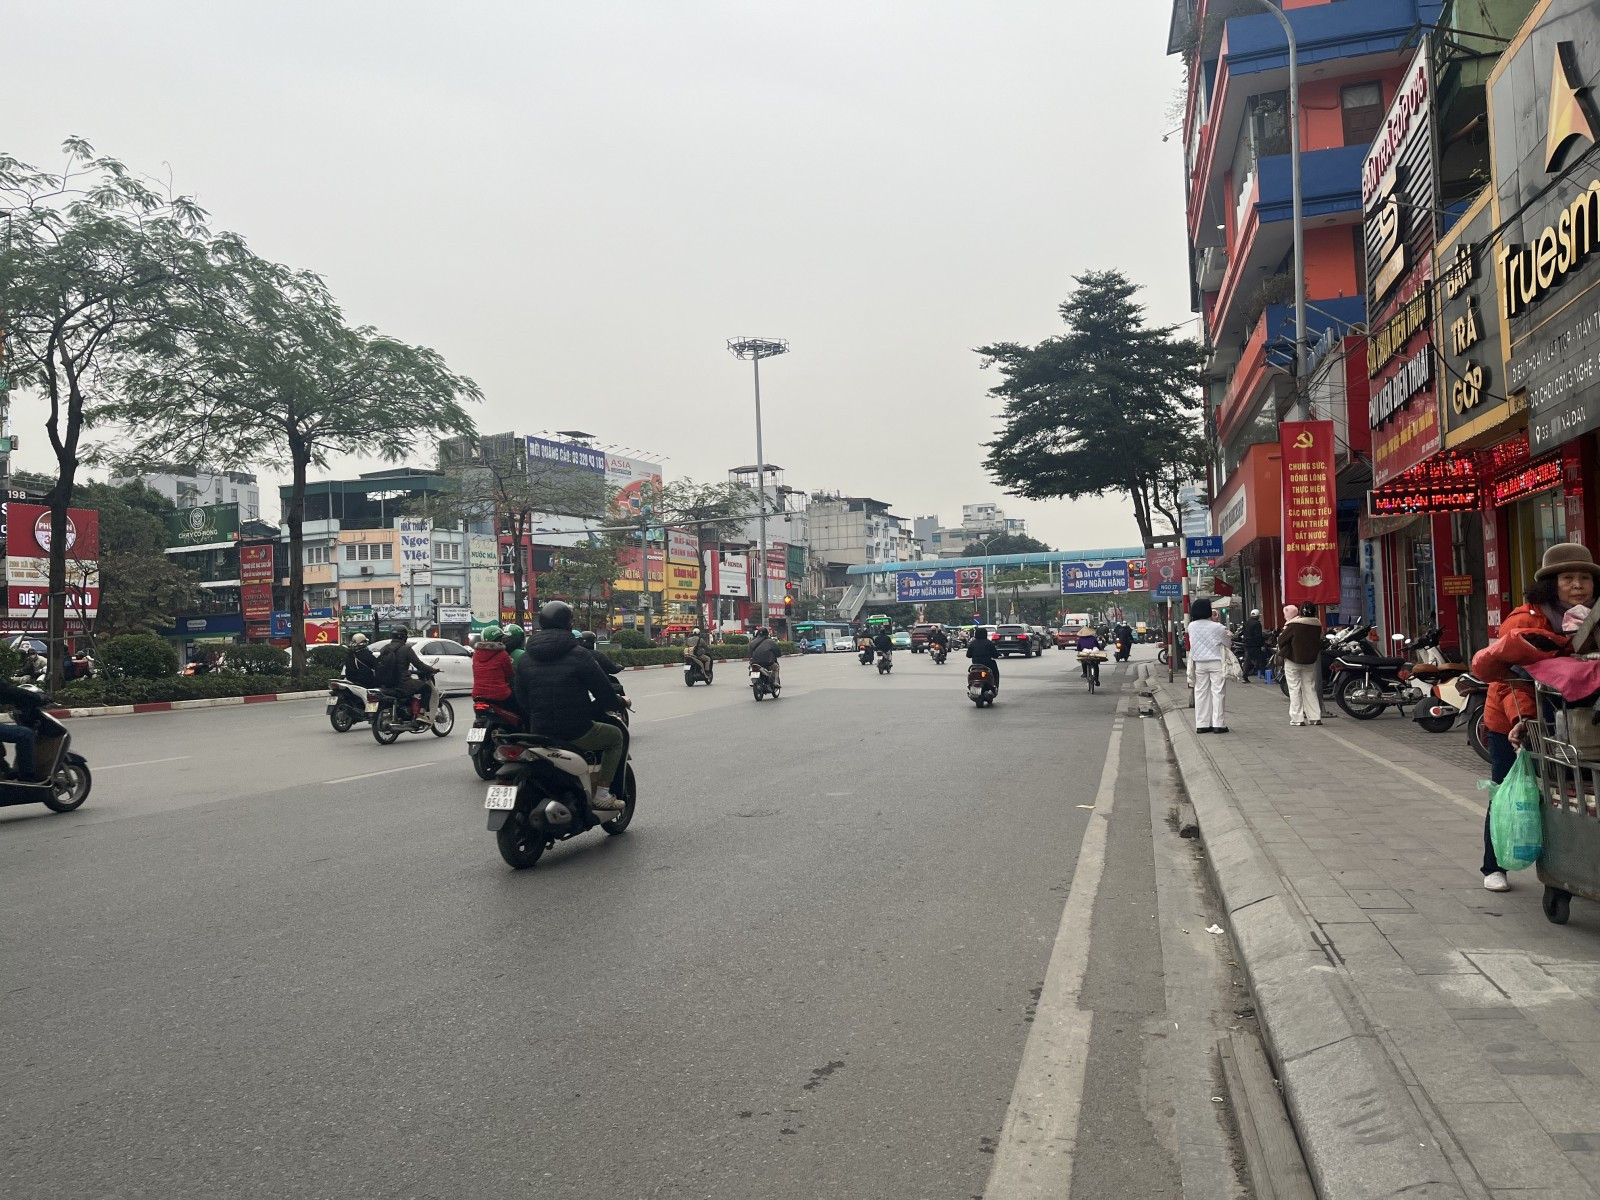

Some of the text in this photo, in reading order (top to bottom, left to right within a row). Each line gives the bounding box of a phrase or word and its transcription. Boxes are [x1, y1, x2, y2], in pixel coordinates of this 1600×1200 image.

[1446, 243, 1473, 300] BÁN
[1451, 295, 1478, 356] TRẢ
[1453, 360, 1483, 415] GÓP
[611, 459, 631, 469] ASIA
[1289, 463, 1310, 471] CHUNG
[1292, 485, 1326, 494] THỰC HIỆN
[8, 490, 26, 500] 198
[1315, 497, 1325, 506] LỢI
[1288, 508, 1332, 517] CÁC MỤC TIÊU
[1293, 517, 1329, 528] PHÁT TRIỂN
[401, 536, 429, 547] Ngọc
[1287, 542, 1299, 551] ĐẾN
[1112, 569, 1124, 577] PHIM
[1075, 577, 1125, 588] APP NGÂN HÀNG
[909, 588, 920, 597] APP
[938, 586, 954, 595] HÀNG
[2, 619, 19, 629] SỬA
